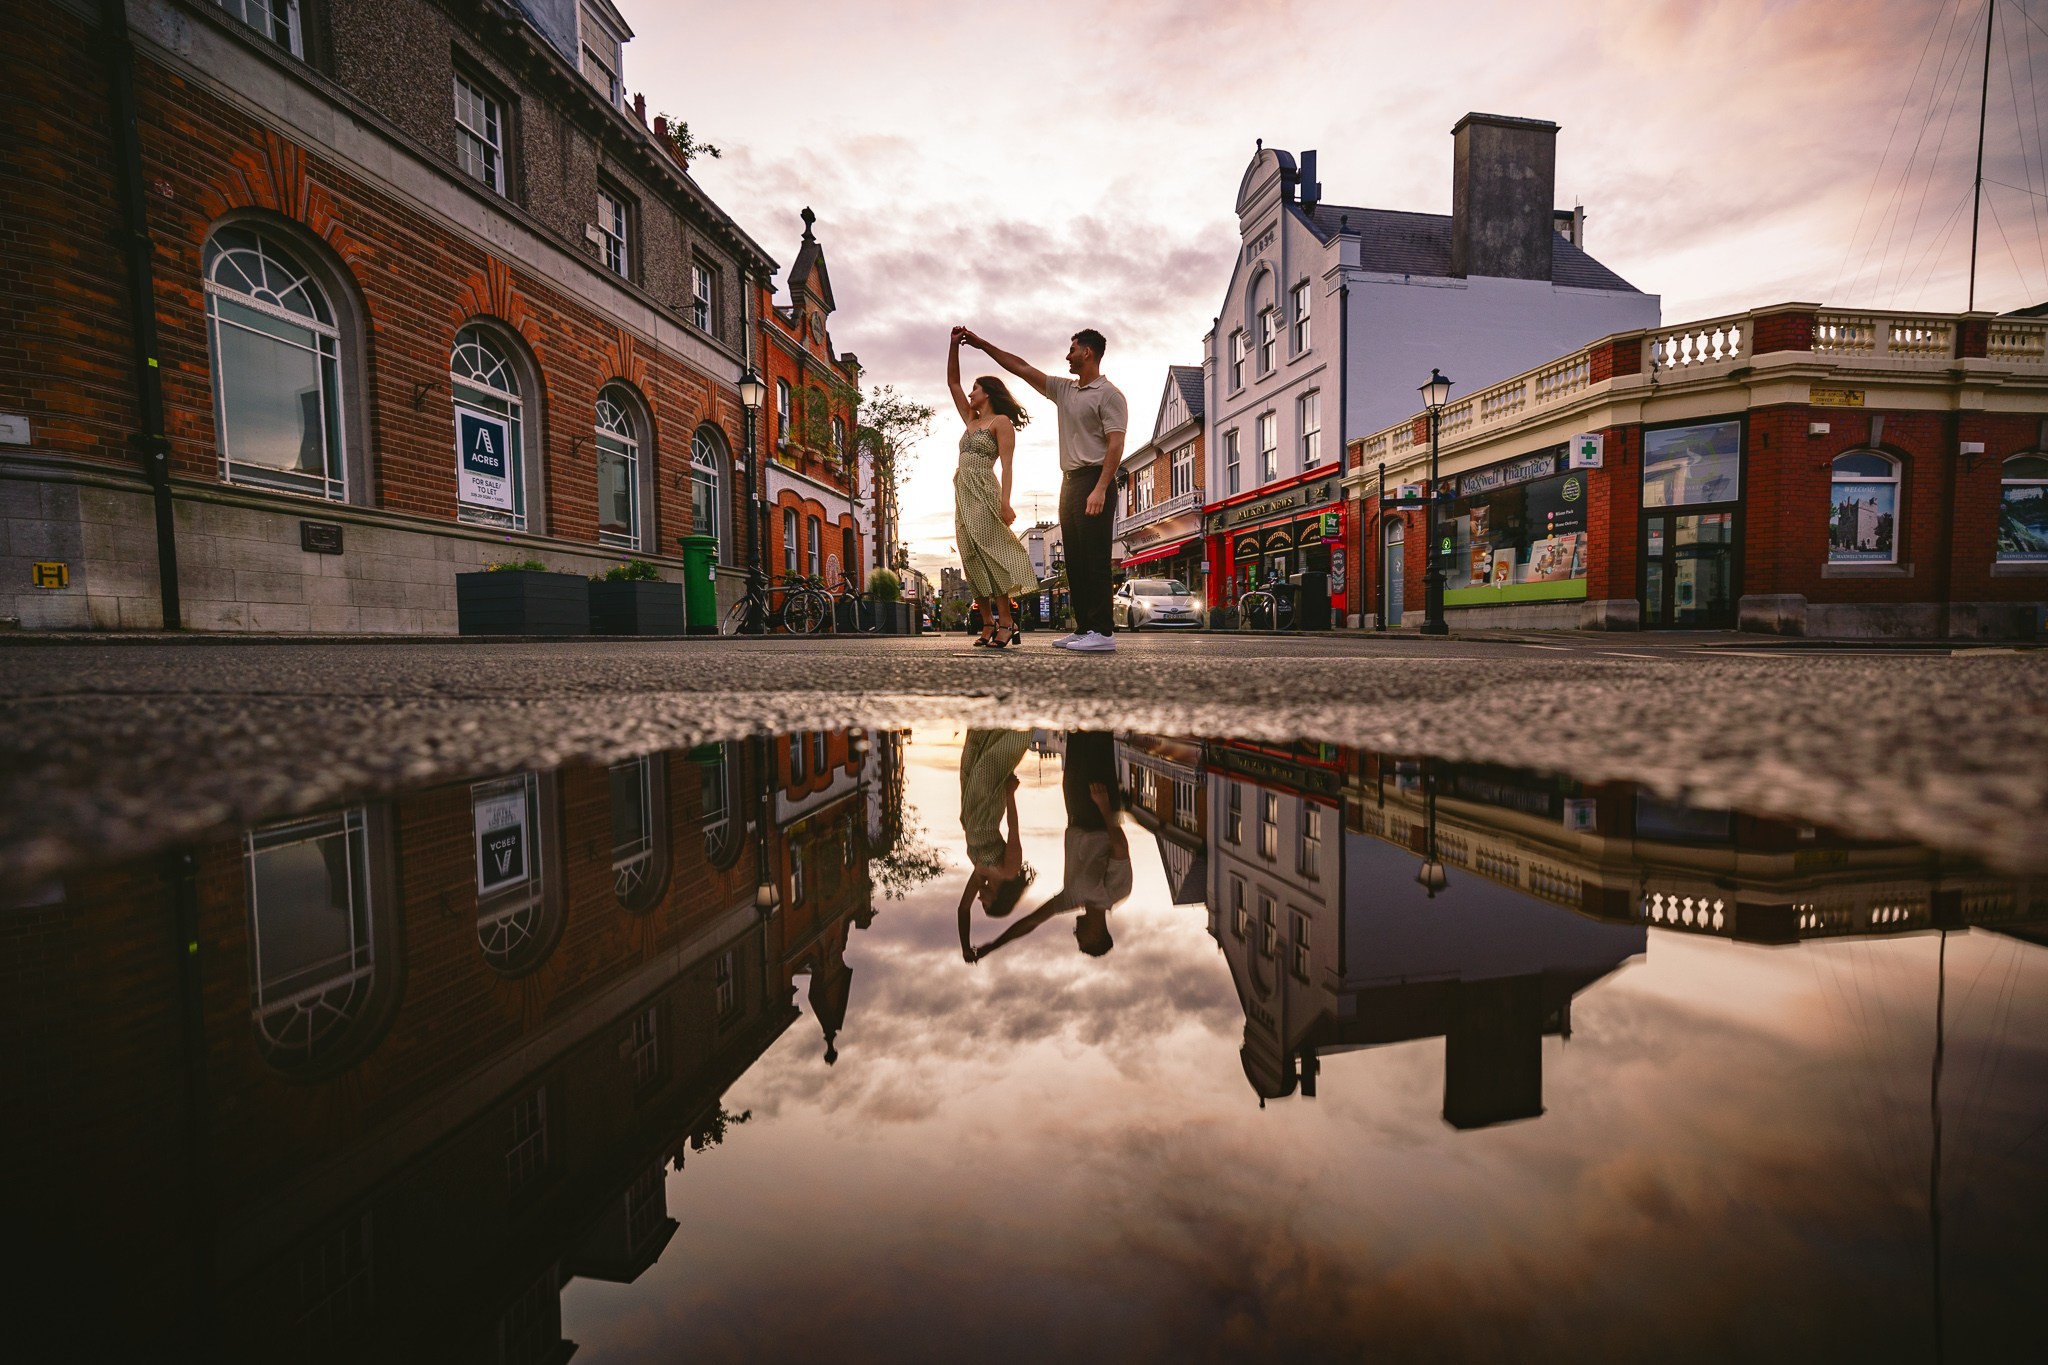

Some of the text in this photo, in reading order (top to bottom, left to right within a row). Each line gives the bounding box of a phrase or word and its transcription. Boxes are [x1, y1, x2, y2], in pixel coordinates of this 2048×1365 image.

[471, 452, 499, 467] ACRES
[472, 477, 484, 486] FOR
[1462, 458, 1551, 492] Maxwell Pharmacy
[486, 488, 497, 496] LET
[1270, 497, 1294, 511] NEWS
[38, 564, 64, 587] H
